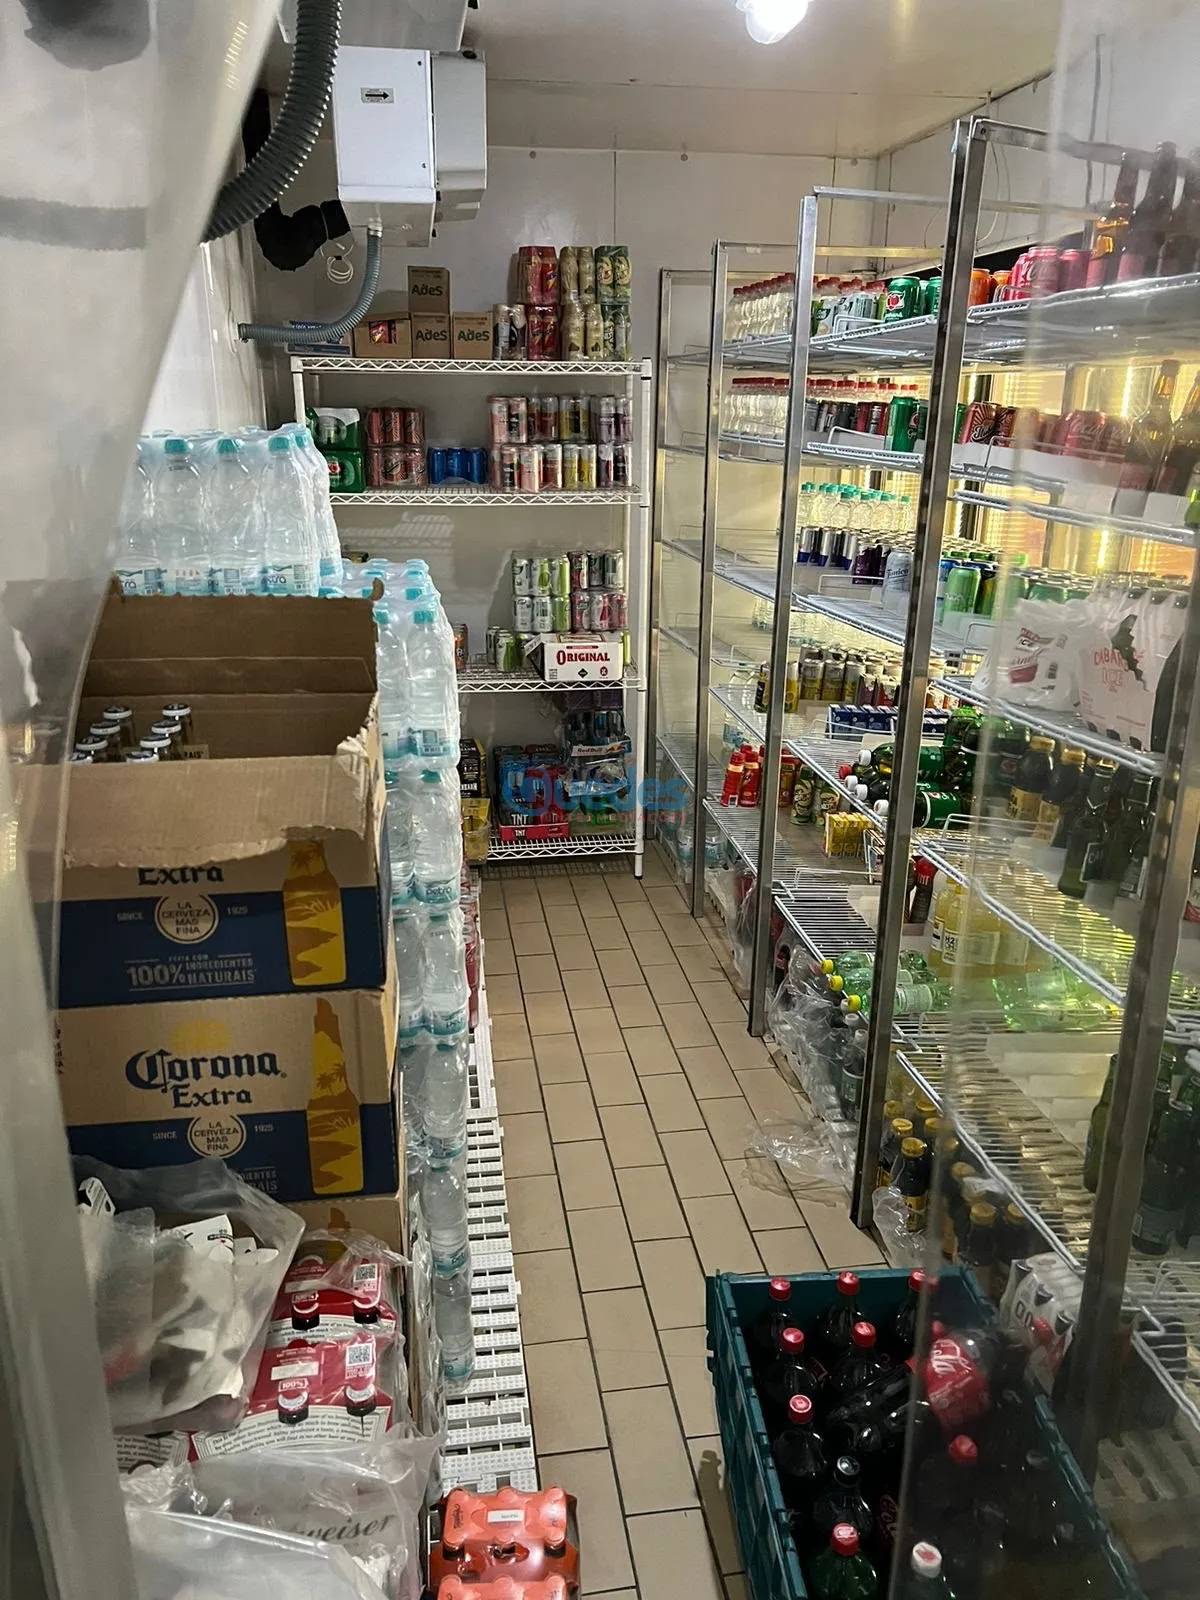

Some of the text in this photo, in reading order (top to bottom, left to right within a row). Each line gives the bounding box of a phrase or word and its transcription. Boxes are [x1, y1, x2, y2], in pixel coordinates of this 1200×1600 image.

[556, 649, 611, 666] ORIGINAL
[511, 814, 529, 826] TNT
[177, 900, 193, 909] LA
[161, 907, 211, 919] CERVEZA
[175, 918, 199, 927] MAS
[176, 926, 201, 935] FINA
[185, 958, 254, 971] INGREDIENTES
[126, 963, 186, 986] 100%
[125, 1048, 281, 1094] Corona
[170, 1082, 253, 1109] Extra
[208, 1121, 223, 1129] LA
[193, 1127, 239, 1138] CERVEZA
[206, 1136, 229, 1144] MAS
[206, 1143, 230, 1151] FINA
[299, 1513, 399, 1542] weiser
